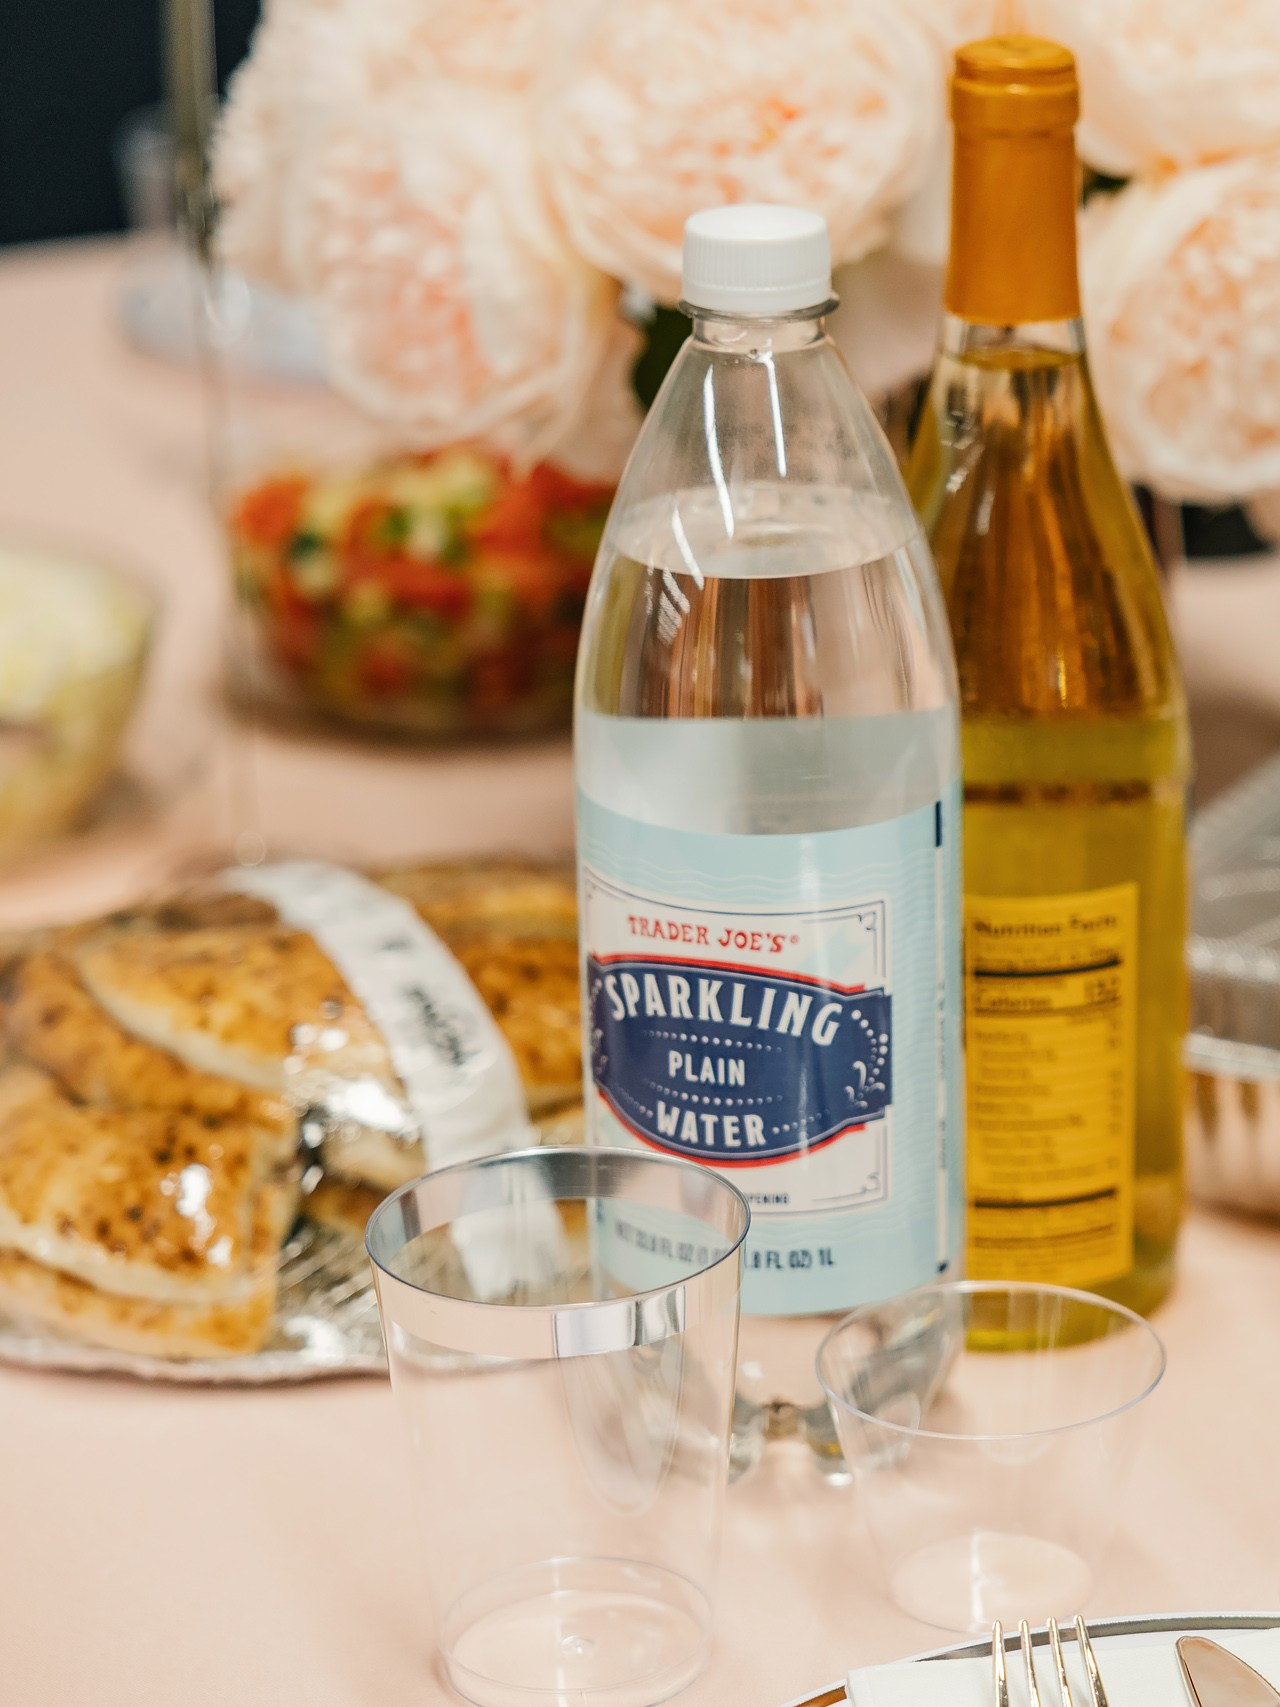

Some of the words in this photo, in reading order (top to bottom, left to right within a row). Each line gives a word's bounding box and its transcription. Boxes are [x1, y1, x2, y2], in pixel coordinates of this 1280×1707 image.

[628, 914, 709, 946] TRADER
[604, 972, 843, 1046] SPARKLING
[668, 1050, 746, 1087] PLAIN
[656, 1100, 767, 1147] WATER
[765, 1250, 783, 1269] FL
[818, 1246, 834, 1266] 1L
